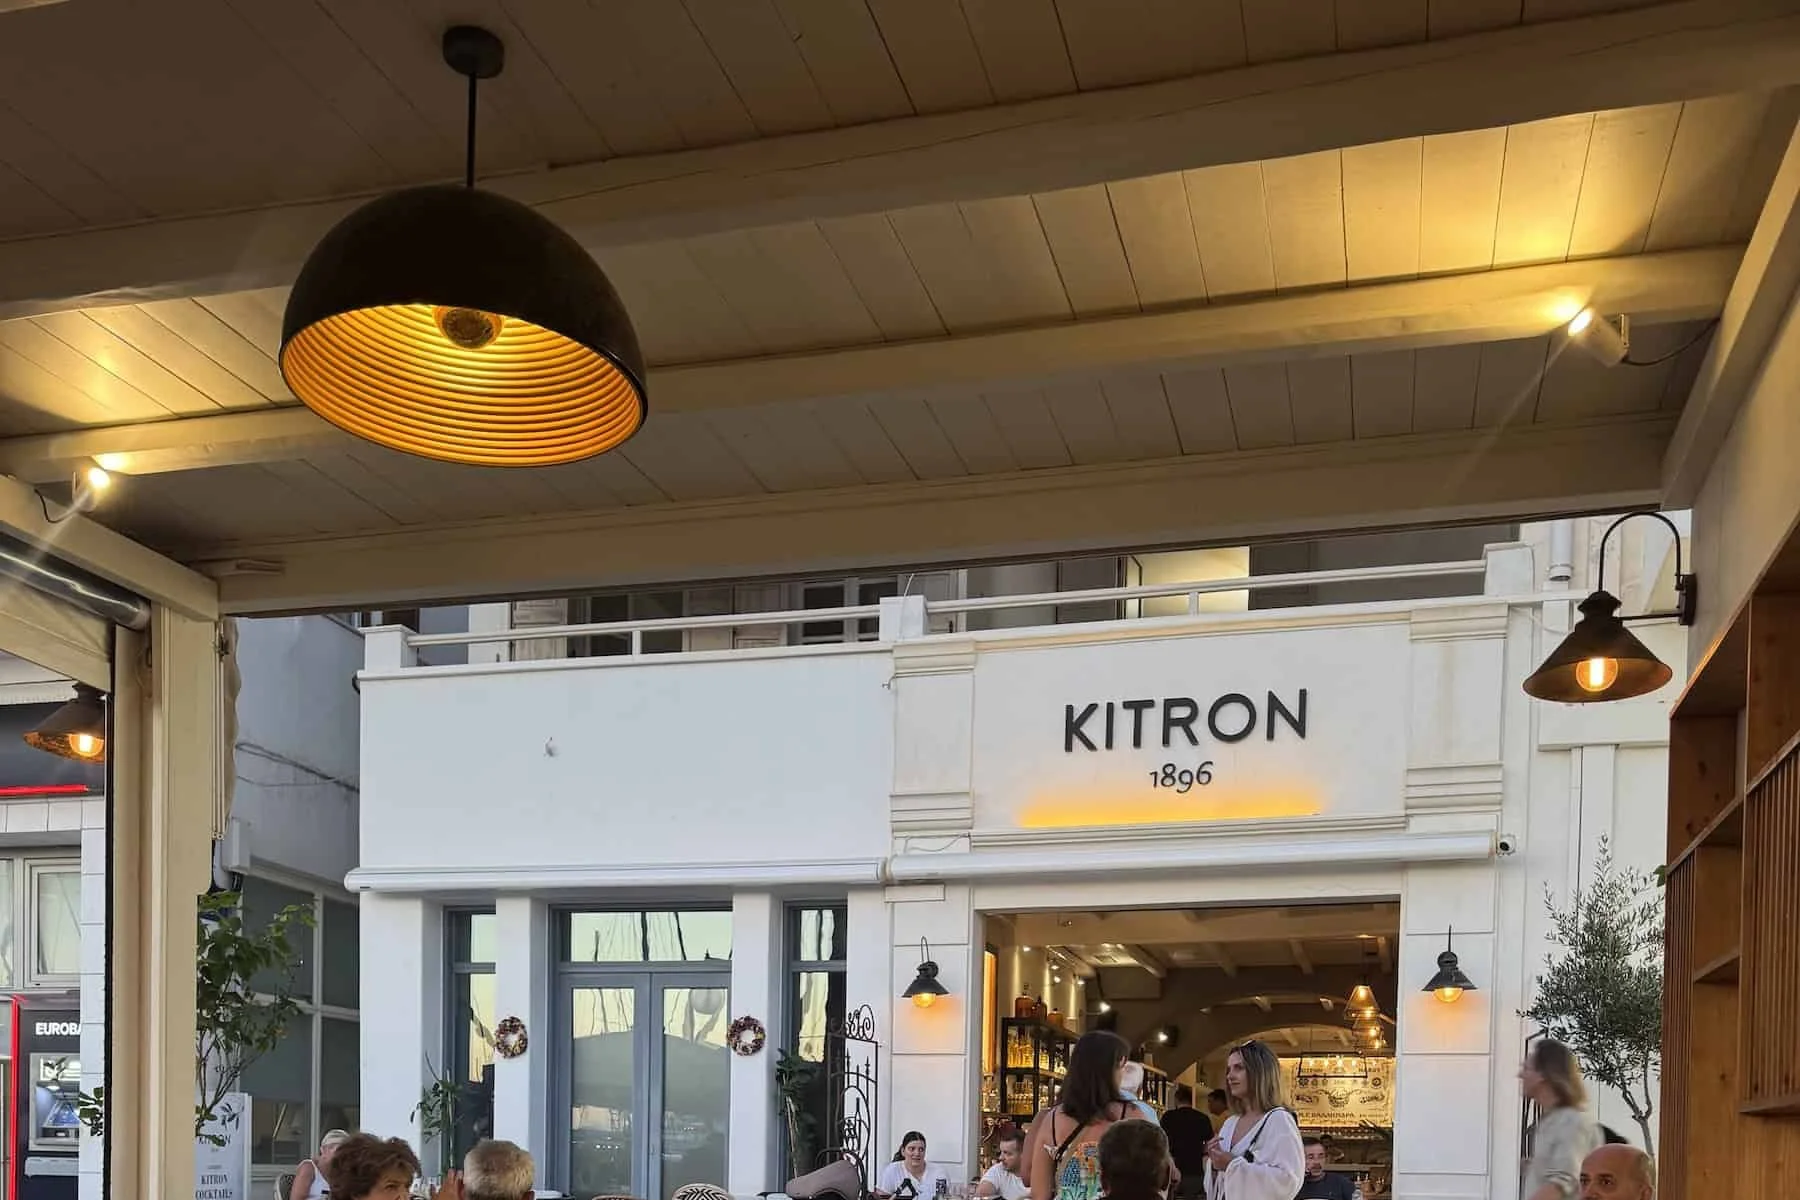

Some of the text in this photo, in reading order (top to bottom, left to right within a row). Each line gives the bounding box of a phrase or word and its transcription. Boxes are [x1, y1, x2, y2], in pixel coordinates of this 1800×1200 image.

[1065, 688, 1308, 752] KITRON
[1149, 761, 1213, 793] 1896
[201, 1174, 229, 1184] KITRON
[195, 1189, 232, 1200] COCKTAILS
